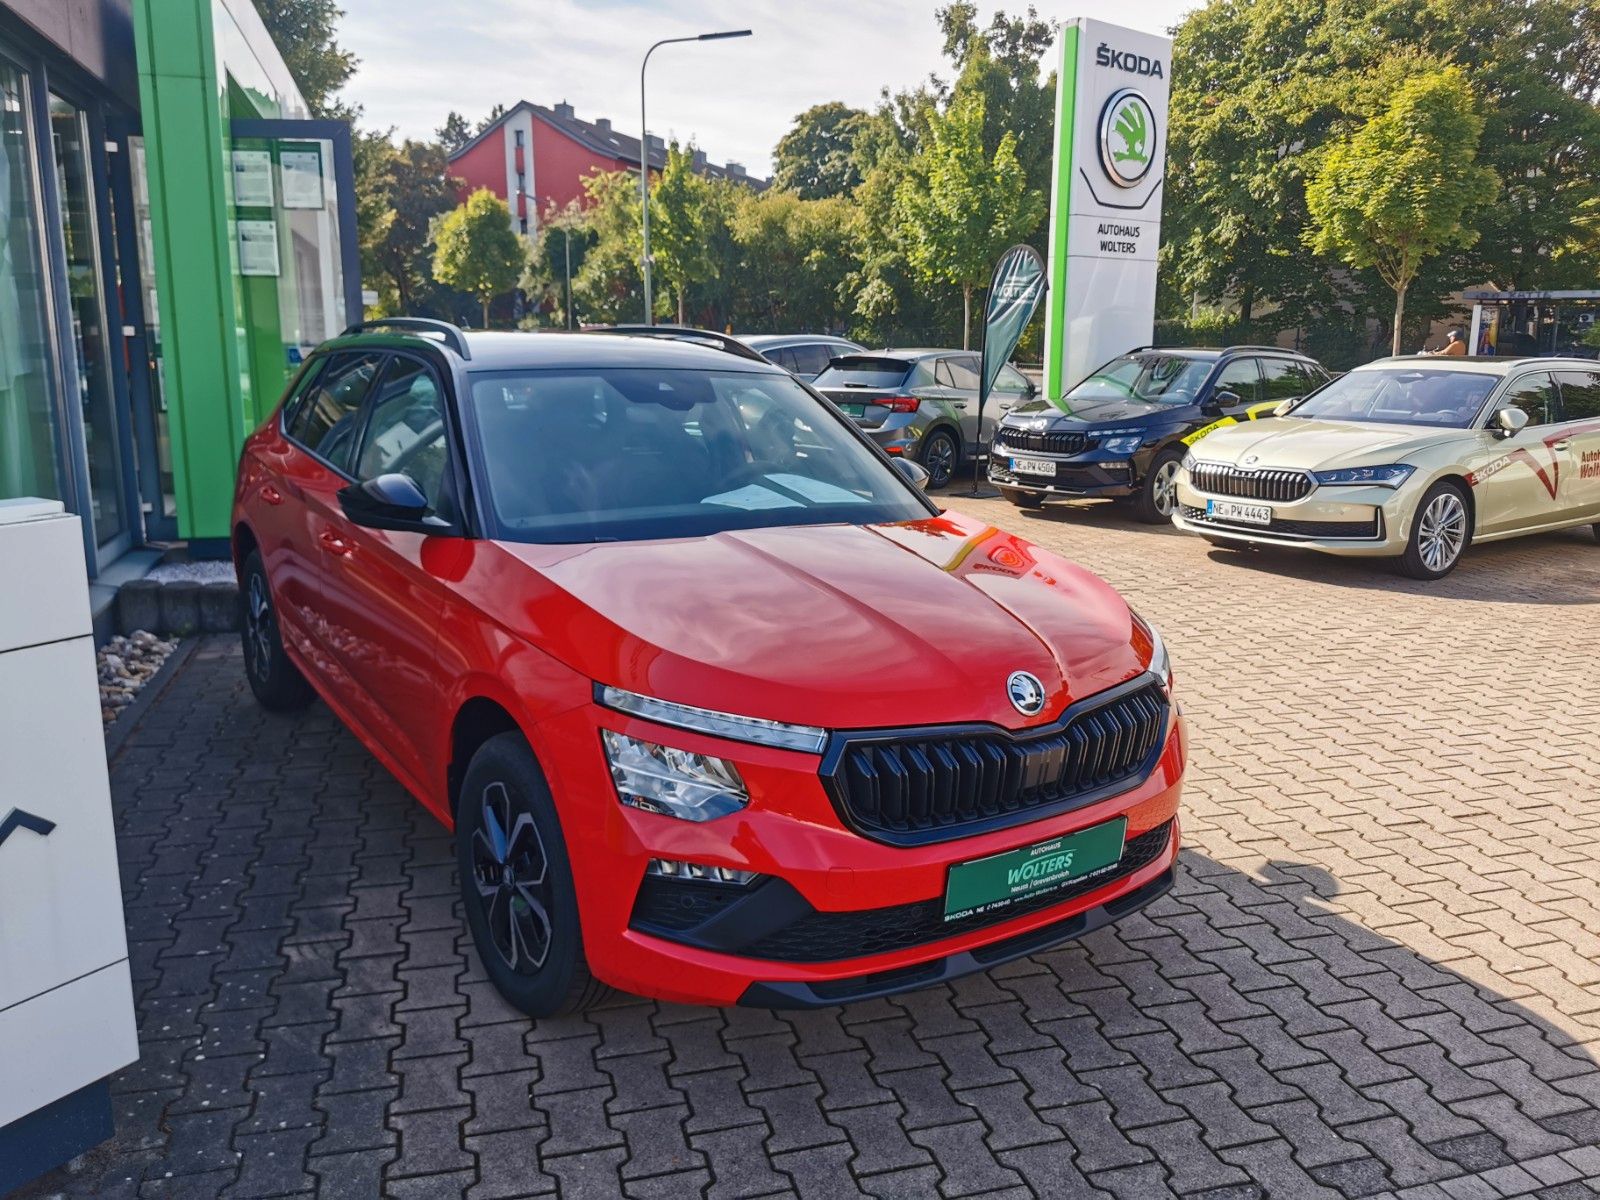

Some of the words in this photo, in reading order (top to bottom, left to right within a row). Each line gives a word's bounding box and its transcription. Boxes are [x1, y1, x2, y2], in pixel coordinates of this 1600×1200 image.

[1096, 42, 1163, 79] ŠKODA
[1097, 223, 1140, 237] AUTOHAUS
[1100, 240, 1136, 253] WOLTERS
[1580, 462, 1600, 479] Wolt
[1214, 503, 1224, 515] NE
[1231, 504, 1242, 517] PW
[1244, 507, 1269, 521] 4443
[1030, 841, 1061, 856] AUTOHAUS
[1008, 850, 1074, 885] WOLTERS
